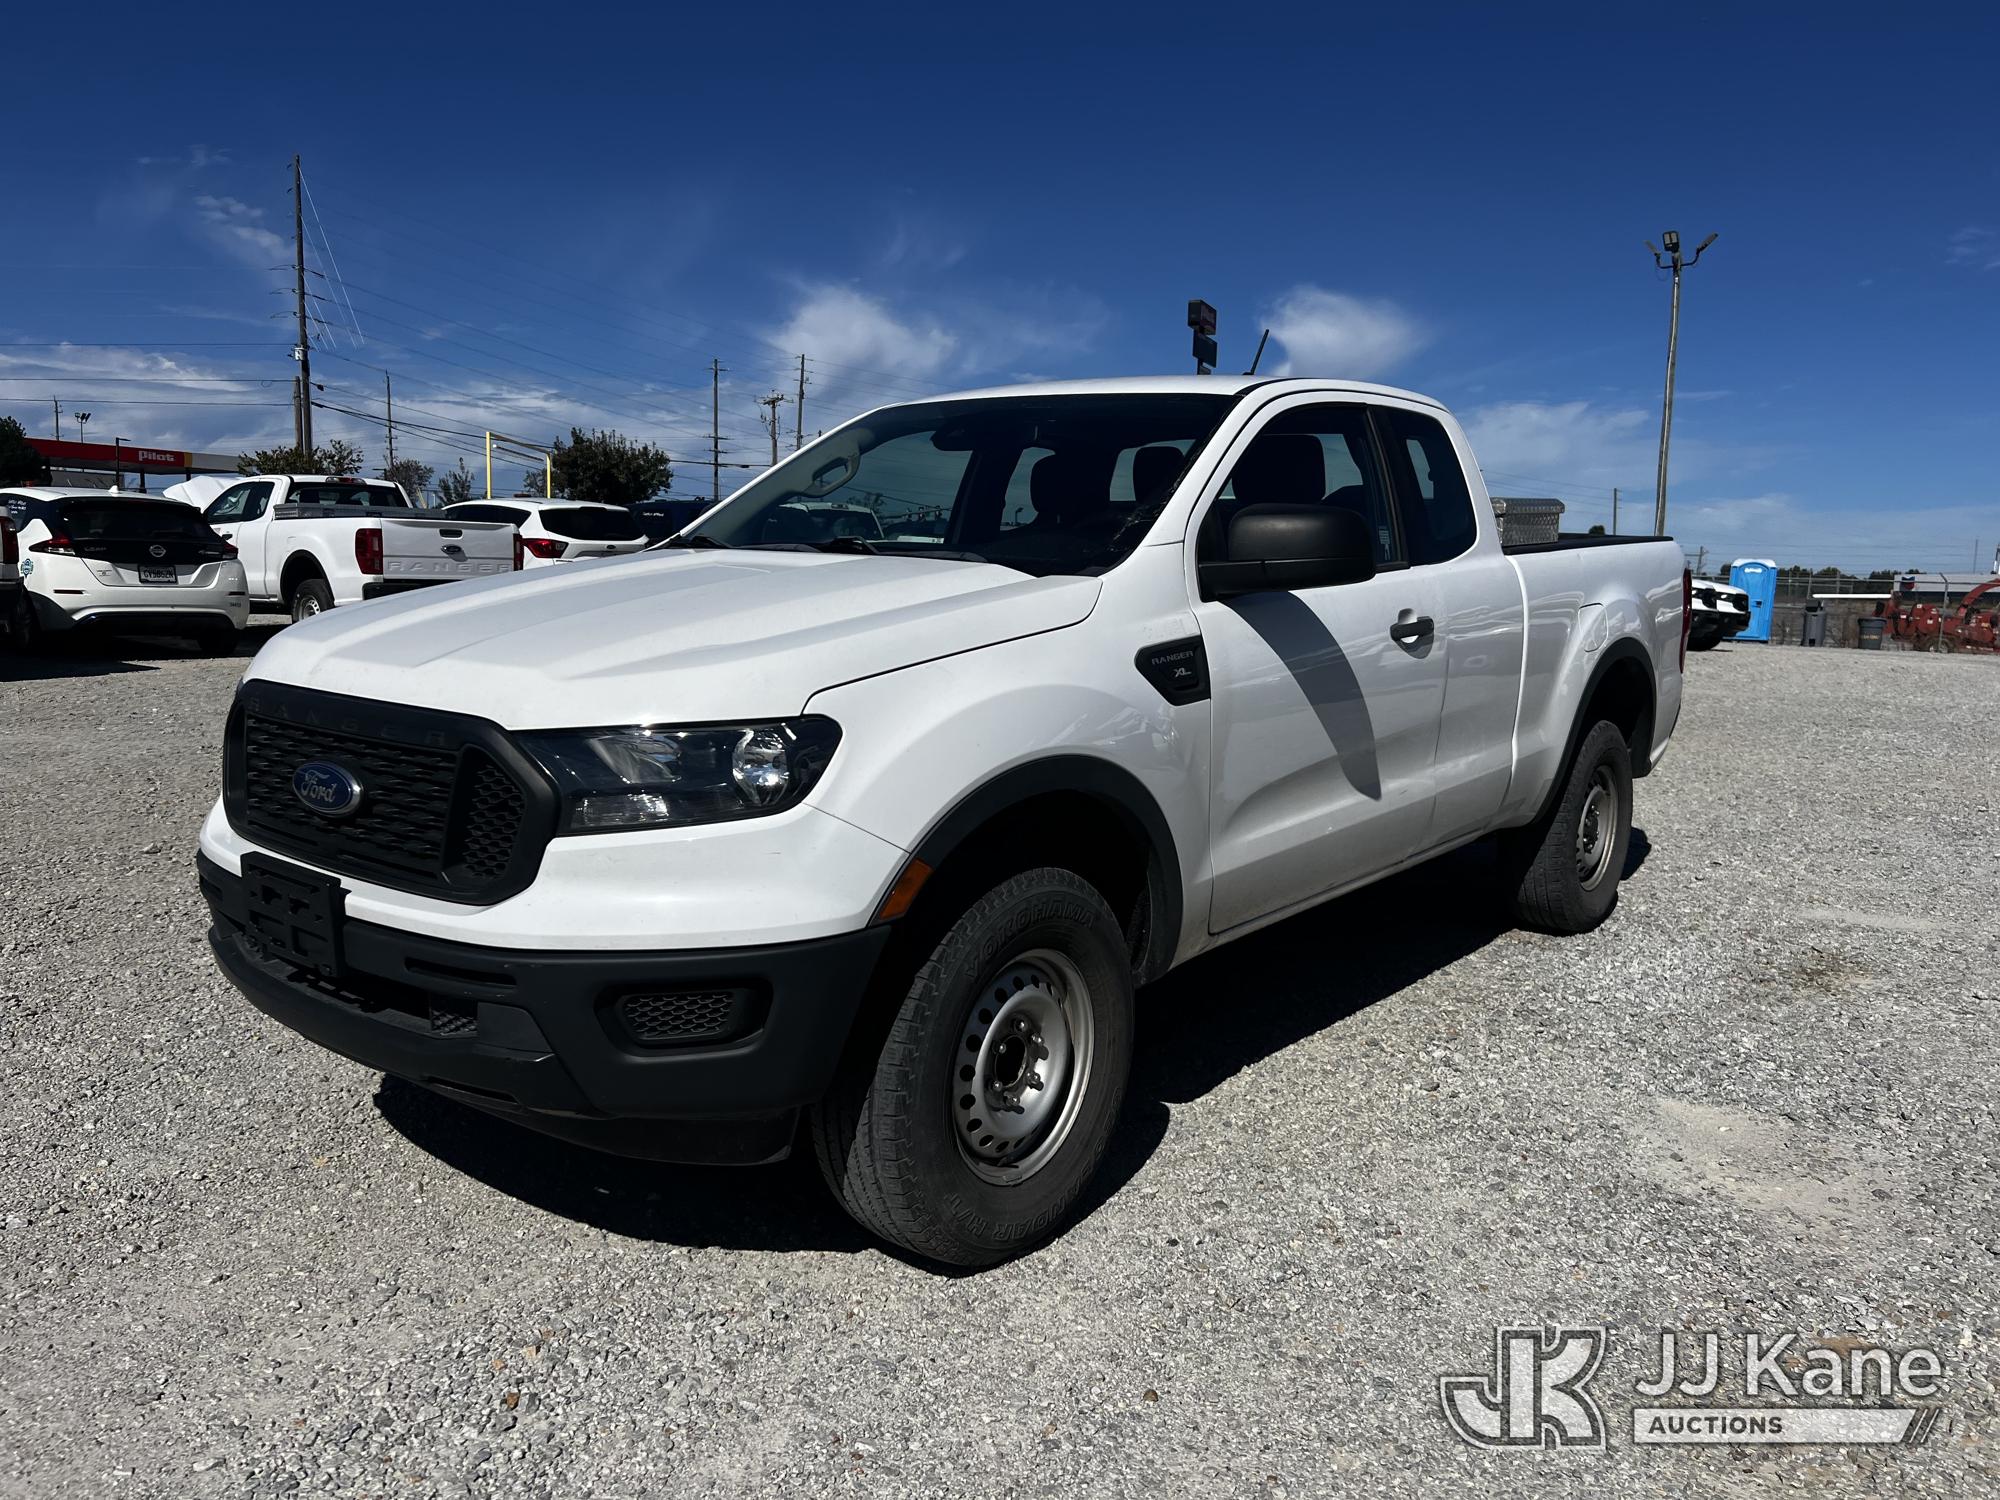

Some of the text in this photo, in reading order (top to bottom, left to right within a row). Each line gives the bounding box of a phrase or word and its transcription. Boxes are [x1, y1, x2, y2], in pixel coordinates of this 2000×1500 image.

[138, 450, 175, 462] Pilot
[387, 561, 513, 574] RANGER
[1151, 650, 1194, 666] RANGER
[1173, 667, 1192, 679] XL
[300, 769, 337, 802] Ford
[965, 898, 1097, 981] YOKOHAMA
